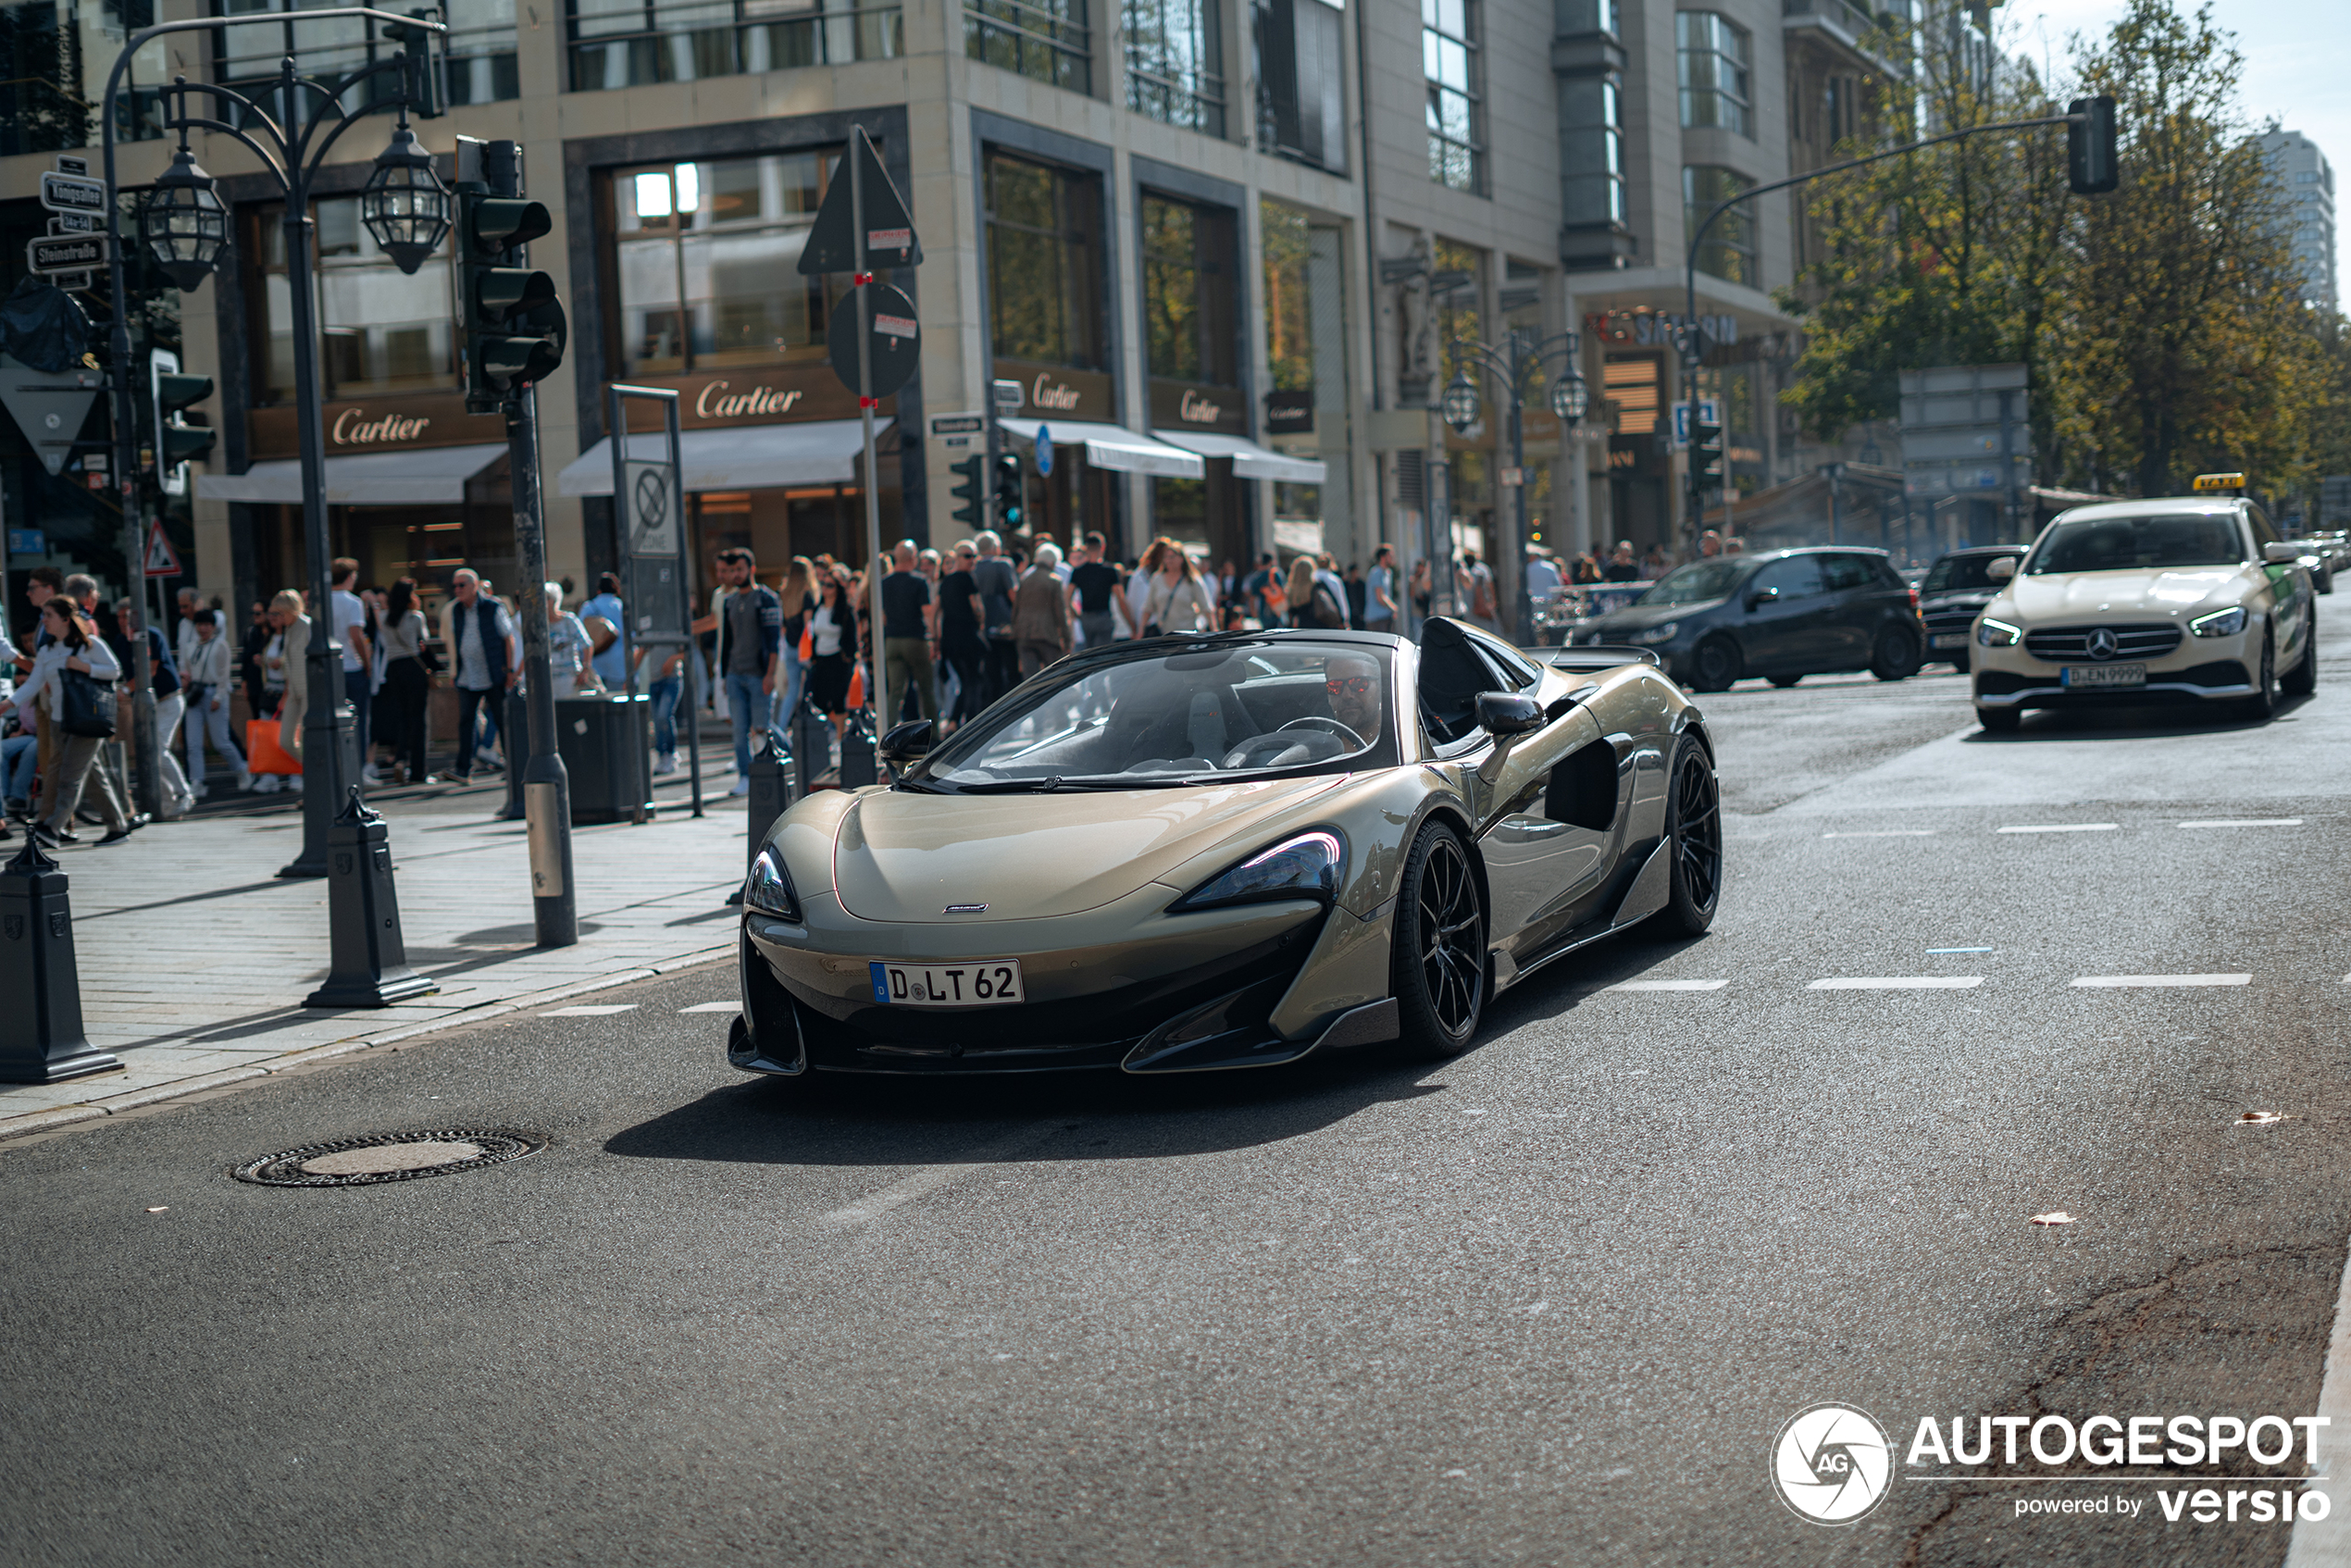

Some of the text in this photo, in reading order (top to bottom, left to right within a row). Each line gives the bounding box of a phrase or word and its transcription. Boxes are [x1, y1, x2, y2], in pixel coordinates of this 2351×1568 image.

[52, 182, 100, 204] Königsallee
[38, 243, 96, 262] Steinstraße
[696, 380, 802, 418] Cartier
[1032, 371, 1081, 410] Cartier
[1180, 388, 1221, 423] Cartier
[1269, 406, 1308, 420] Cartier
[332, 407, 430, 444] Cartier
[2200, 478, 2237, 487] TAXI
[2088, 668, 2106, 681] EN
[2108, 667, 2143, 680] 9999
[889, 967, 1015, 1001] D LT 62
